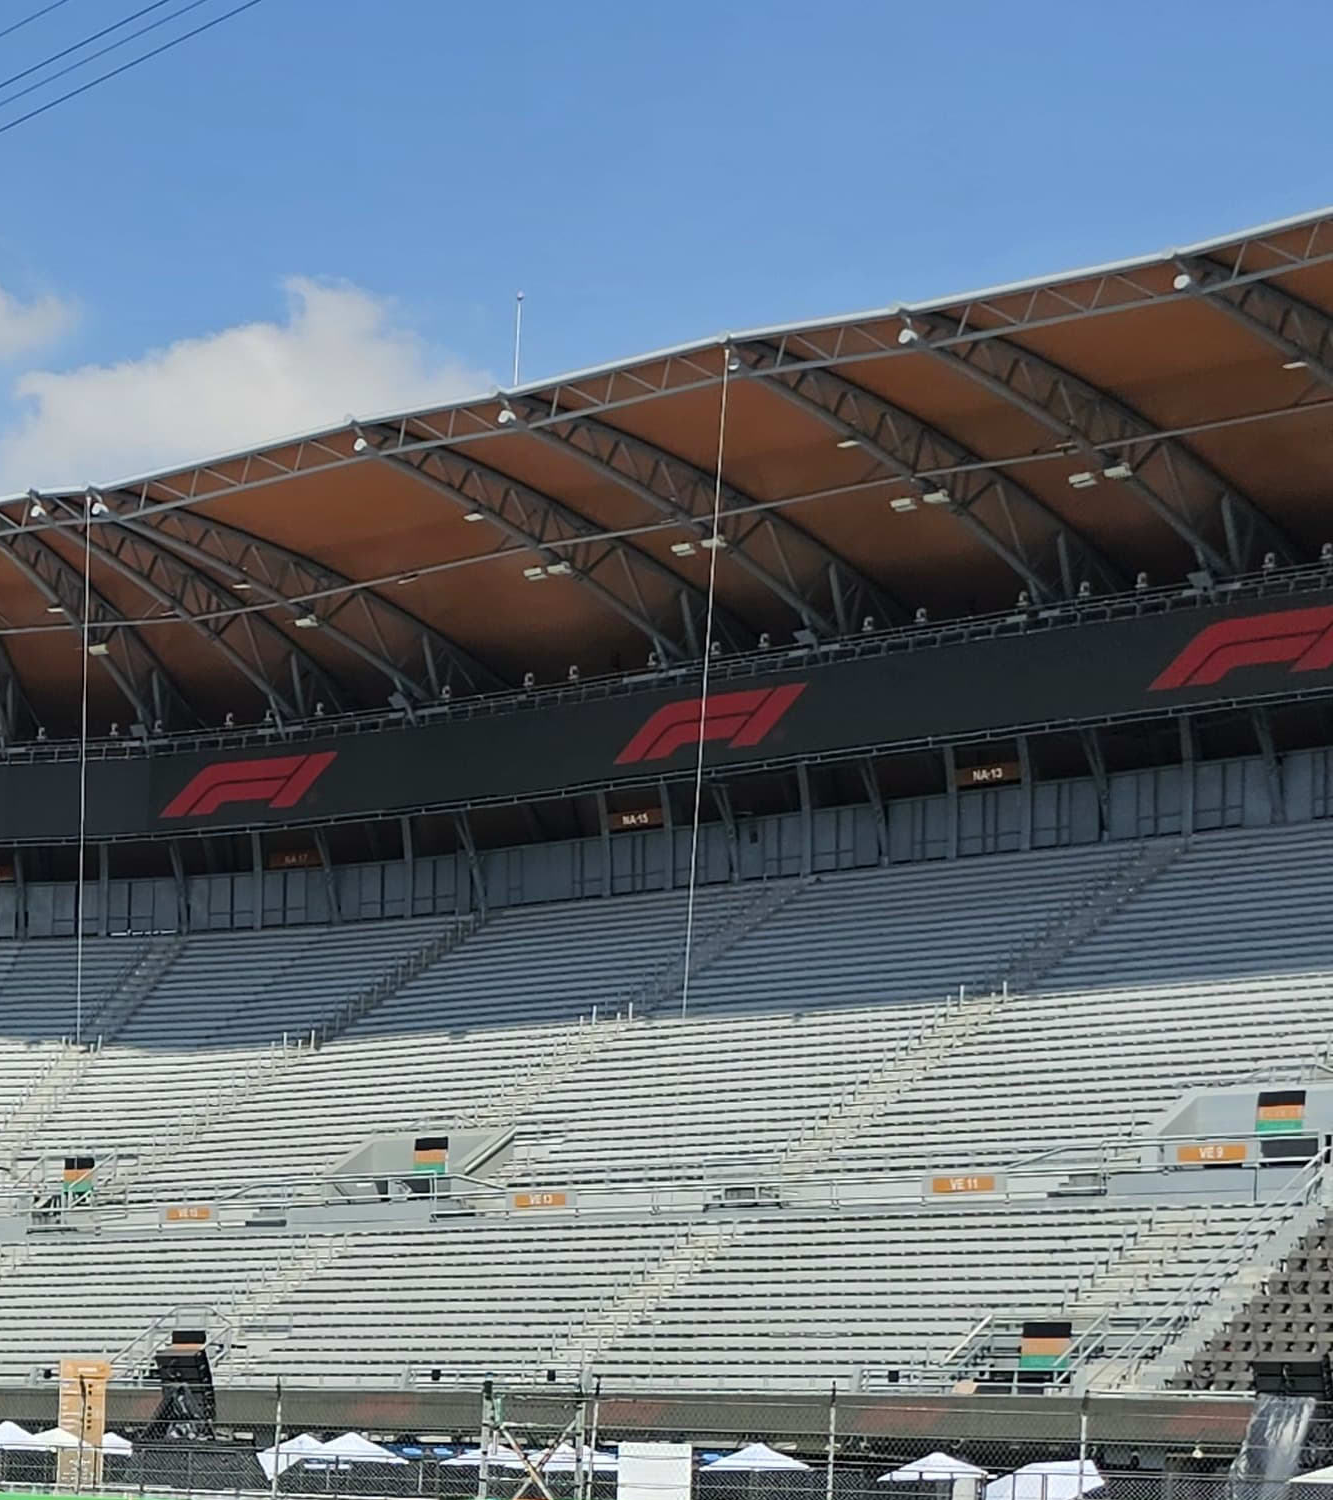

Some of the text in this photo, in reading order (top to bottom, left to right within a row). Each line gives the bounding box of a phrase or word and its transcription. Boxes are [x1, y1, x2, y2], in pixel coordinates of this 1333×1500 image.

[616, 683, 807, 764] F1
[160, 751, 337, 818] F1
[1199, 1146, 1214, 1158] VE
[949, 1178, 978, 1190] VE 11
